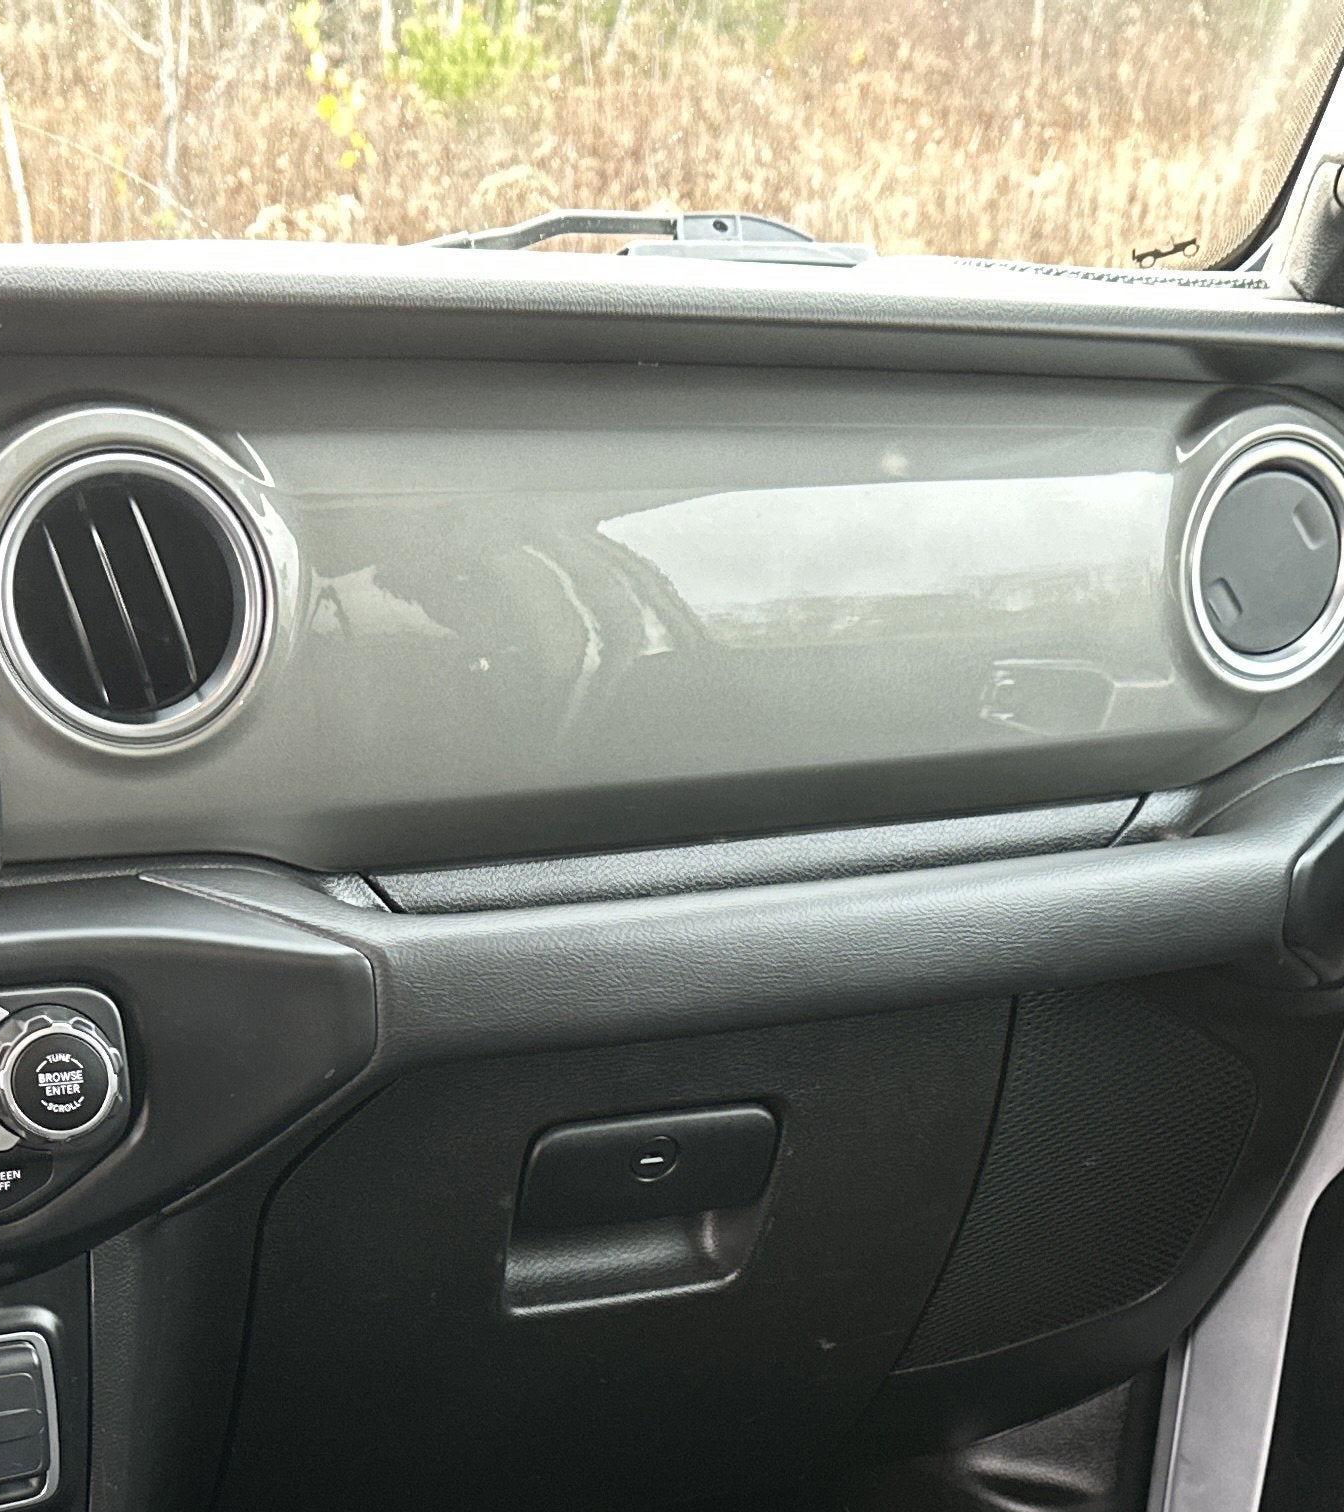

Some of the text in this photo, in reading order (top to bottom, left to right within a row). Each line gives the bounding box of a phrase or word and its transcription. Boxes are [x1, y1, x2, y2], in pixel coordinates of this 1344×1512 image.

[38, 1070, 84, 1084] BROWSE
[45, 1084, 81, 1096] ENTER
[46, 1100, 82, 1113] SCROLL
